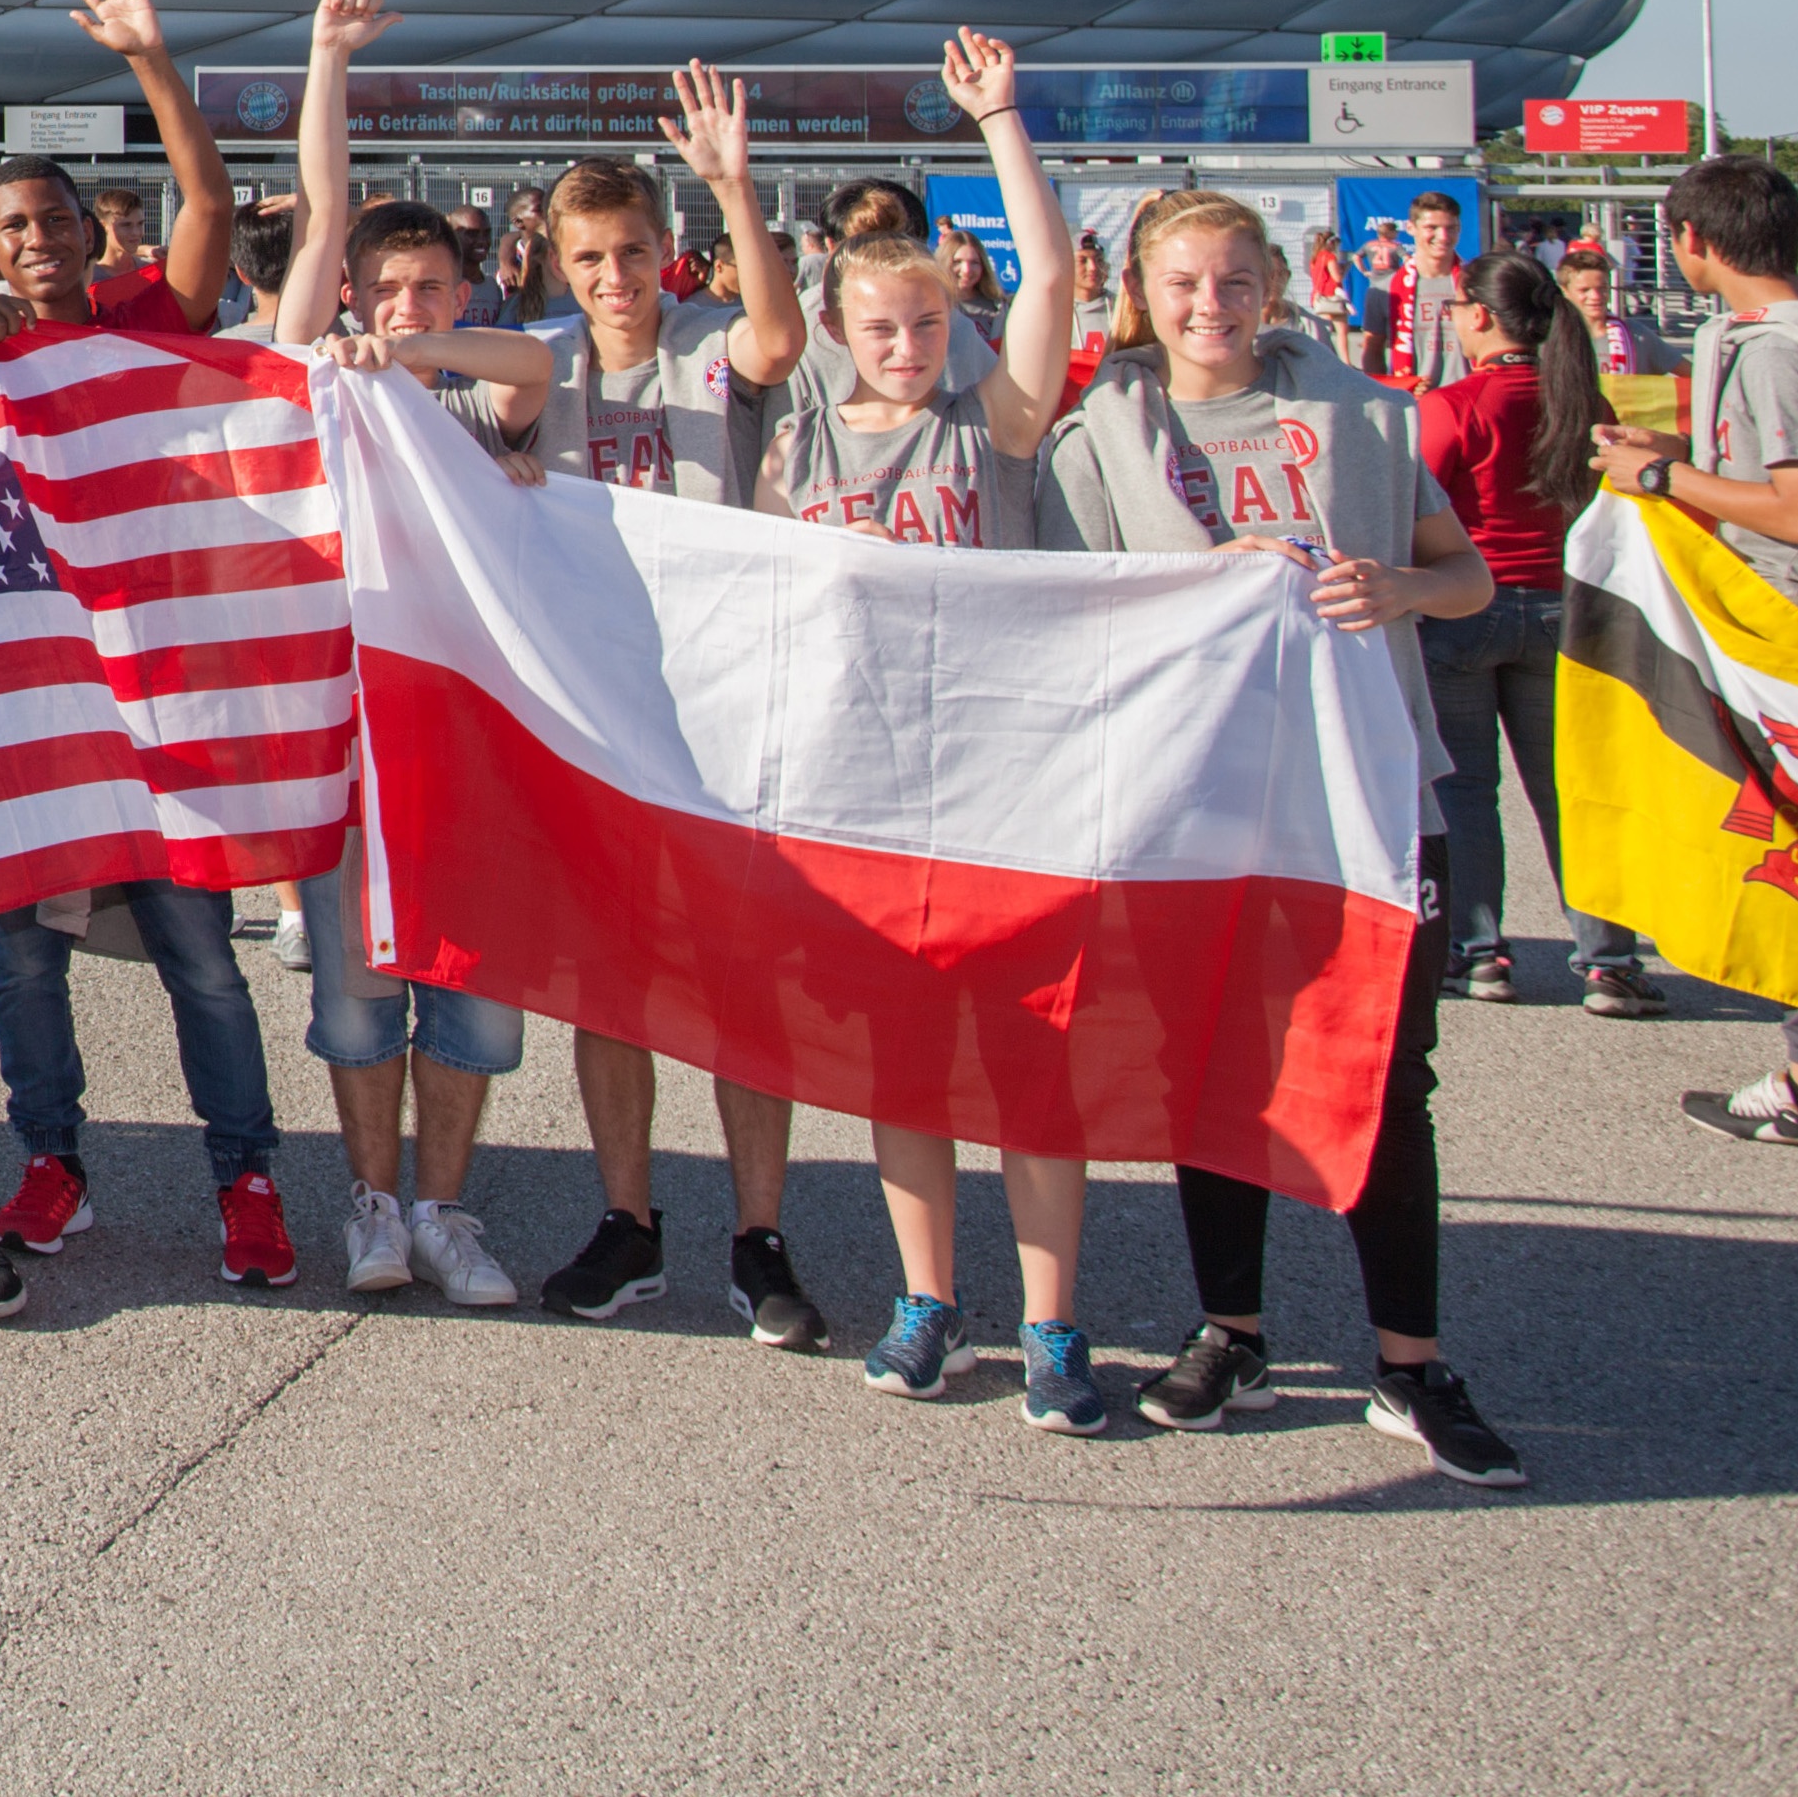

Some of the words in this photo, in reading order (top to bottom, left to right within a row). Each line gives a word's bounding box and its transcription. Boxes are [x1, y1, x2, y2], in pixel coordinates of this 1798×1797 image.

[419, 82, 590, 101] Taschen/Rucksäcke
[597, 83, 657, 103] größer
[1099, 84, 1166, 100] Allianz
[1328, 78, 1383, 93] Eingang
[1386, 78, 1447, 91] Entrance
[30, 110, 61, 121] Eingang
[64, 110, 97, 120] Entrance
[1579, 104, 1604, 115] VIP
[379, 113, 456, 132] Getränke
[509, 115, 539, 131] Art
[544, 114, 603, 132] dürfen
[609, 115, 655, 132] nicht
[796, 115, 870, 133] werden!
[1094, 115, 1146, 131] Eingang
[1161, 115, 1219, 130] Entrance
[236, 191, 249, 202] 17
[474, 192, 488, 203] 16
[1259, 196, 1277, 209] 13
[952, 213, 1005, 229] Allianz
[1179, 438, 1270, 458] FOOTBALL
